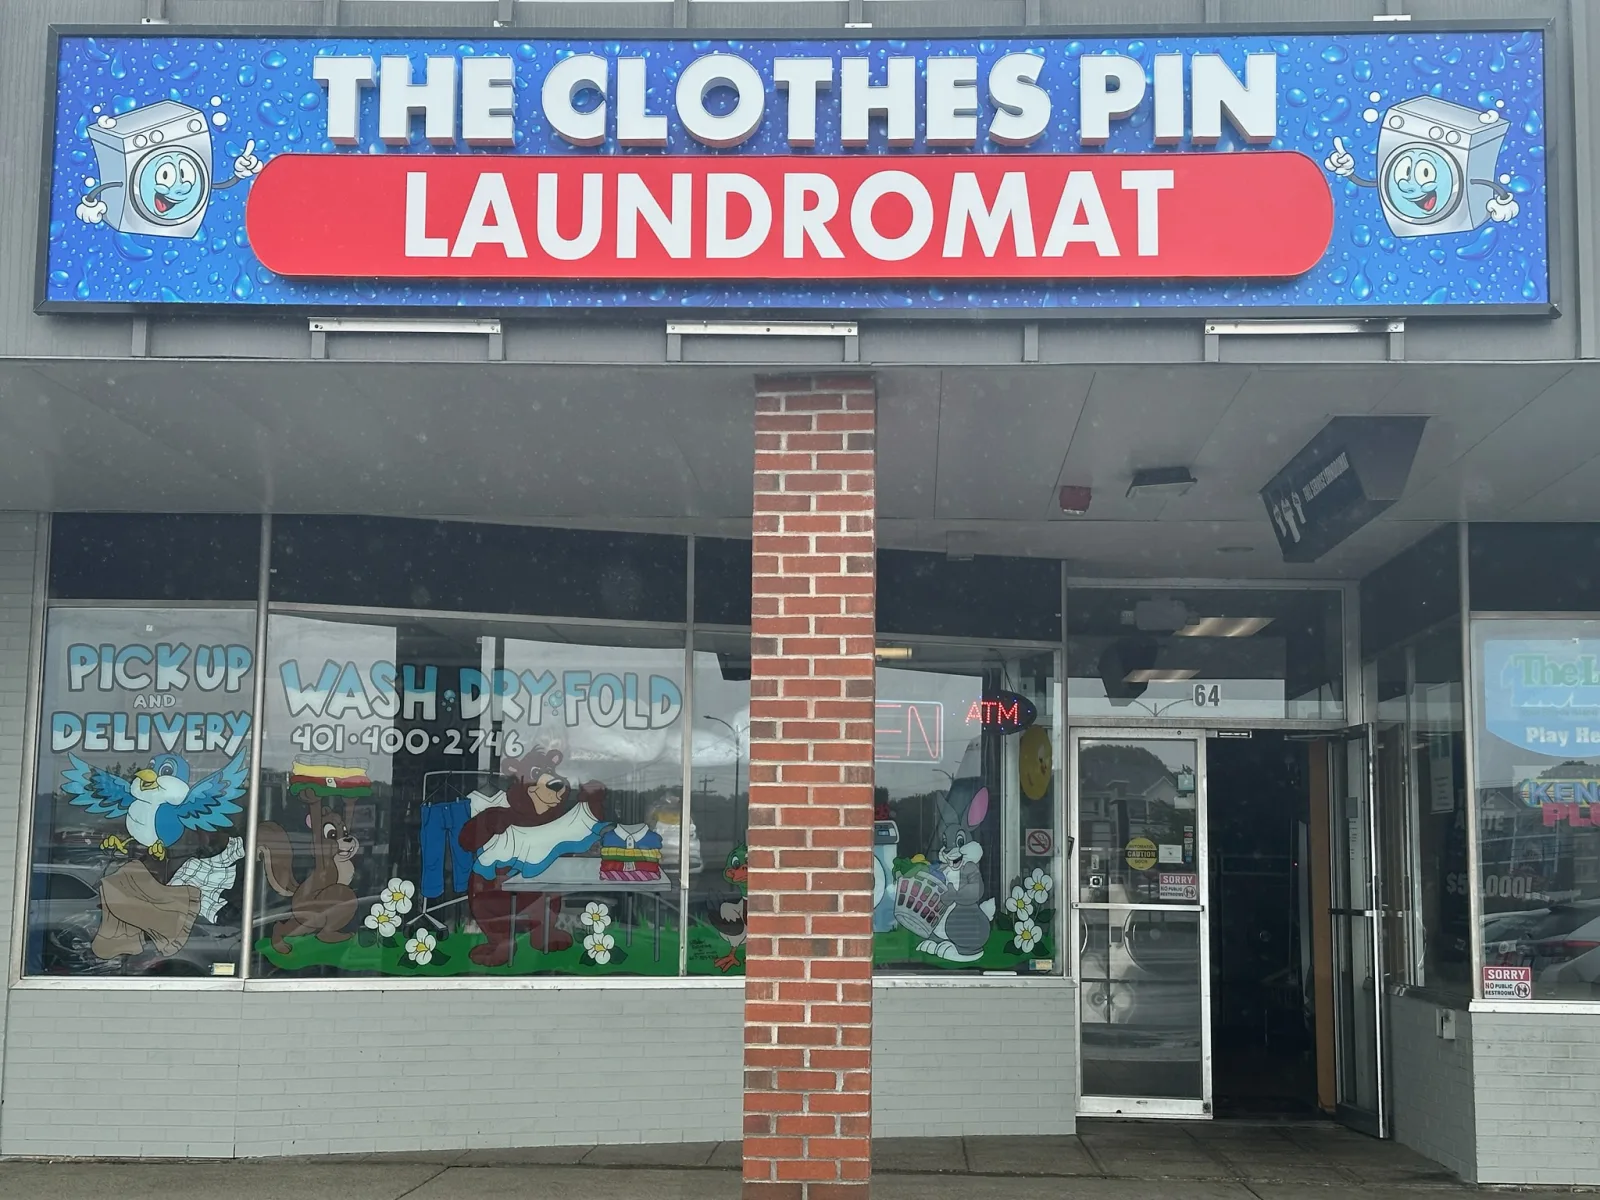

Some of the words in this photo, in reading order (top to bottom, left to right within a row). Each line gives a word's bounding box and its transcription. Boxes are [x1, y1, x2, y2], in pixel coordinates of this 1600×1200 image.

[313, 54, 516, 147] THE
[541, 52, 1052, 148] CLOTHES
[1080, 52, 1277, 146] PIN
[404, 169, 1175, 262] LAUNDROMAT
[67, 643, 193, 693] PICK
[194, 644, 252, 693] UP
[133, 694, 177, 709] AND
[279, 658, 438, 721] WASH
[458, 666, 557, 727] DRY
[562, 670, 683, 730] FOLD
[1193, 684, 1220, 707] 64
[965, 700, 1019, 725] ATM
[50, 710, 252, 757] DELIVERY
[1525, 726, 1569, 747] Play
[1528, 781, 1600, 803] KEN
[1127, 850, 1156, 858] CAUTION
[1162, 875, 1193, 884] SORRY
[1446, 871, 1533, 899] $5,000!
[1487, 969, 1526, 980] SORRY
